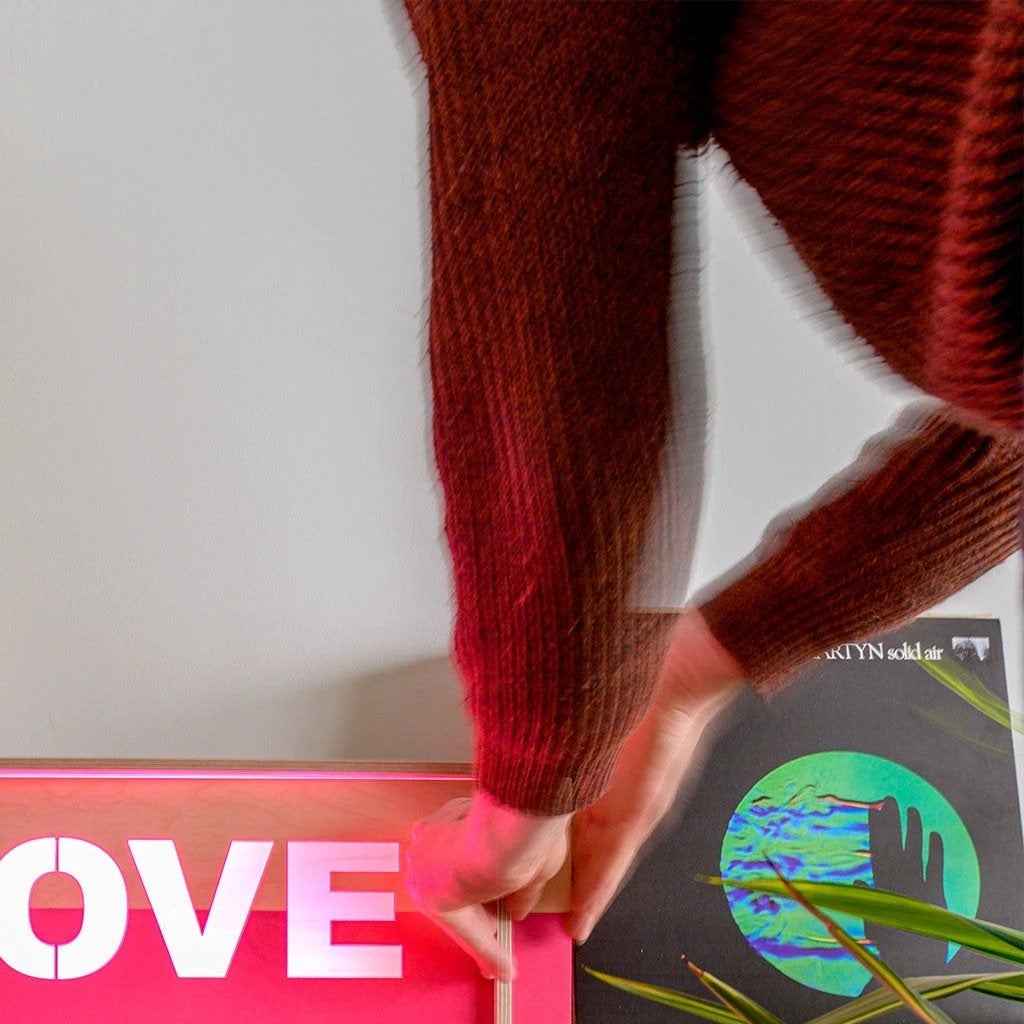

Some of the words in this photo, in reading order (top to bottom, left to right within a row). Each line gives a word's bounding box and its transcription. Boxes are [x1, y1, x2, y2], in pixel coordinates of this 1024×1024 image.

[814, 643, 884, 660] ARTYN
[887, 641, 921, 661] solid
[924, 644, 944, 661] air
